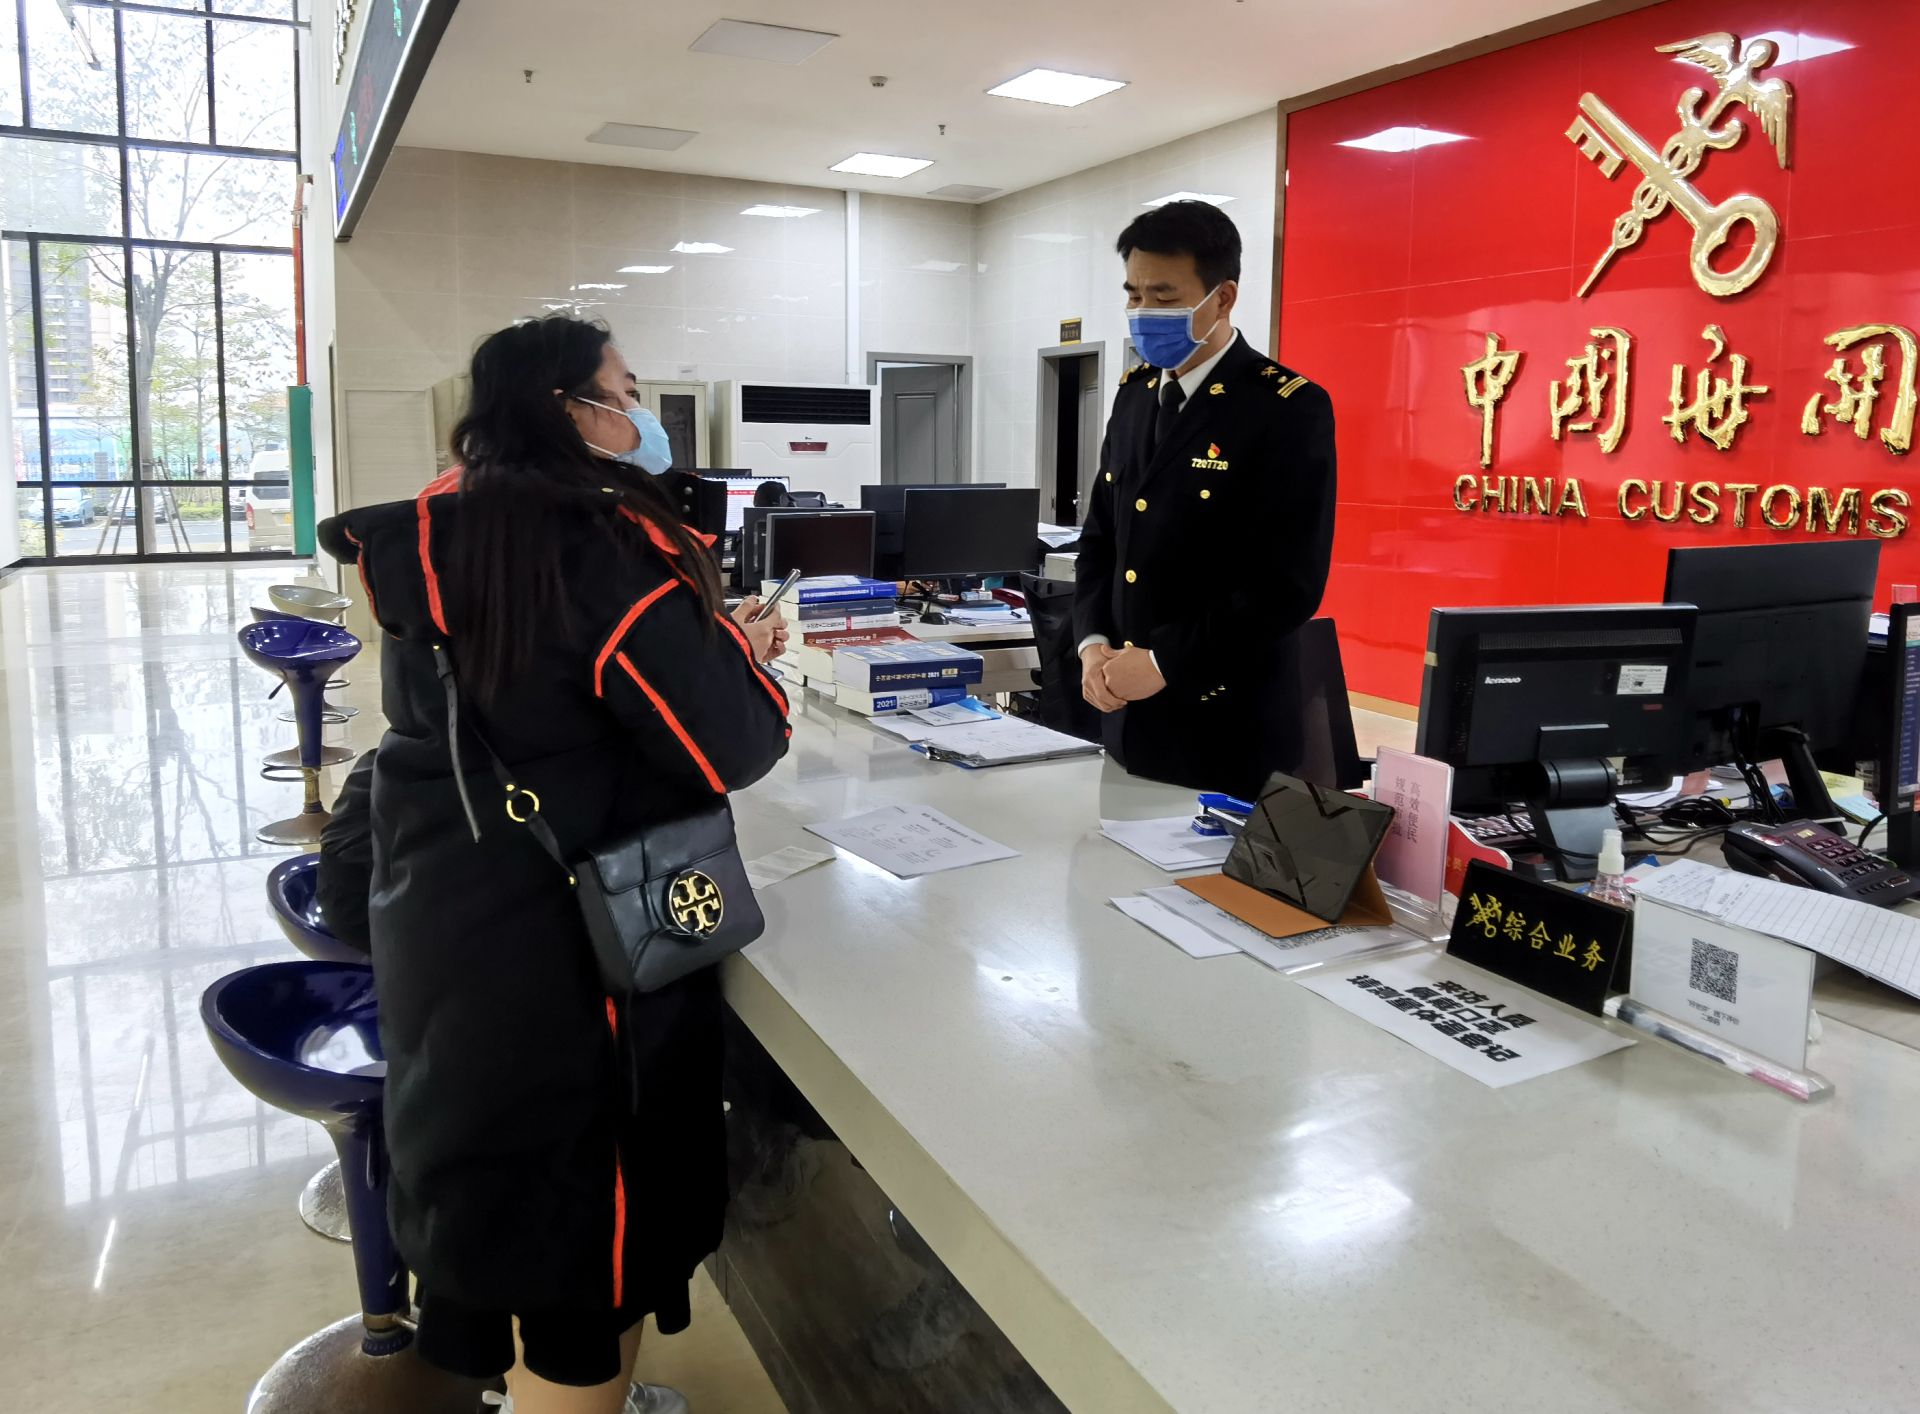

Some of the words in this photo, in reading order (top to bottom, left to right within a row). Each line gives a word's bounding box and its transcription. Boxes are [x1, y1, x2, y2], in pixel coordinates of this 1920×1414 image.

[1191, 457, 1229, 471] 7207720
[1453, 473, 1588, 518] CHINA
[1616, 478, 1911, 538] CUSTOMS
[876, 699, 893, 709] 2021
[1484, 675, 1522, 685] lenovo
[1502, 910, 1606, 972] 综合业务
[1346, 974, 1522, 1063] 请测量体温登记
[1405, 986, 1511, 1036] 佩戴口罩
[1432, 980, 1539, 1029] 来访人员
